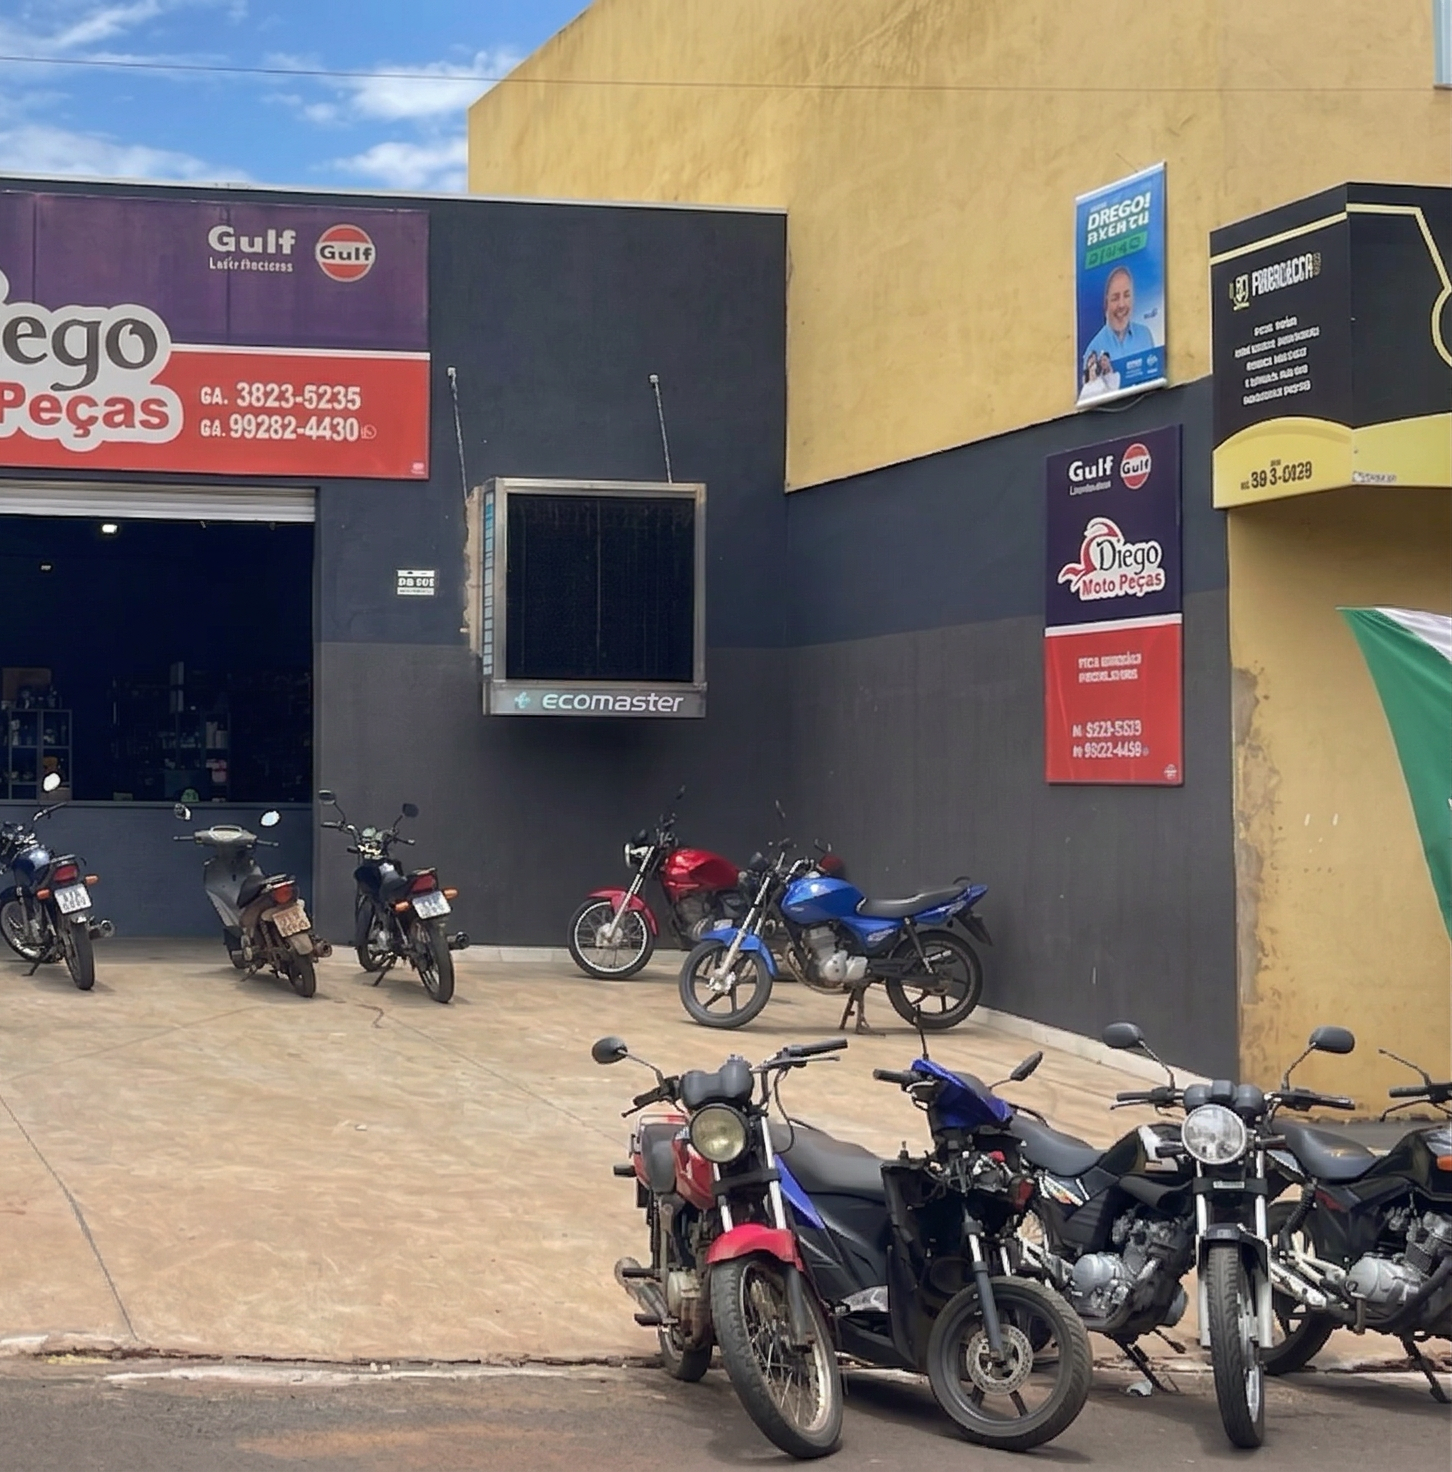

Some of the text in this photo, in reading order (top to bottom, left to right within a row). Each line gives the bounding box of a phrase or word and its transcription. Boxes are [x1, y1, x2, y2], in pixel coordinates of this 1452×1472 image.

[207, 225, 297, 254] Gulf
[319, 244, 373, 262] Gulf
[236, 382, 362, 411] 3823-5235
[229, 413, 360, 442] 99282-4430
[1068, 455, 1114, 482] Gulf
[1122, 458, 1150, 475] Gulf
[1096, 537, 1159, 576] Diego
[1082, 572, 1163, 596] Moto Peças
[542, 692, 685, 712] ecomaster
